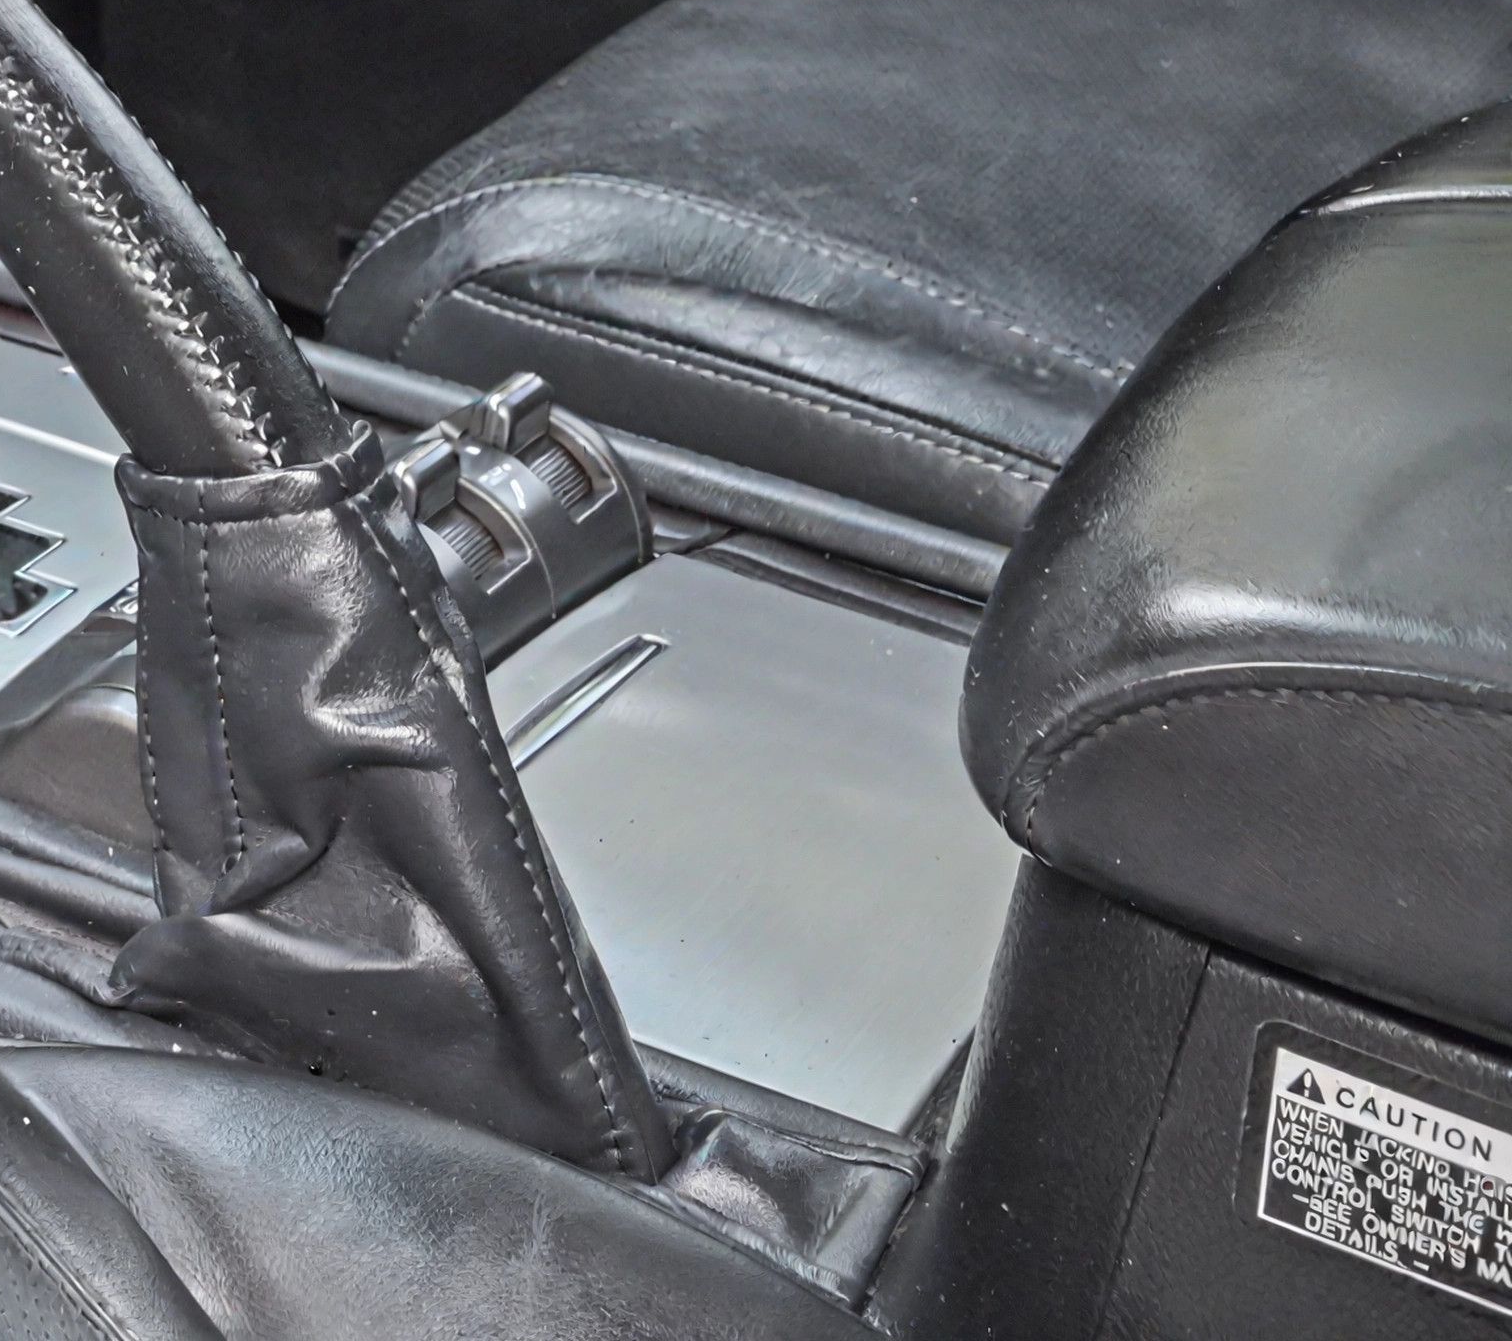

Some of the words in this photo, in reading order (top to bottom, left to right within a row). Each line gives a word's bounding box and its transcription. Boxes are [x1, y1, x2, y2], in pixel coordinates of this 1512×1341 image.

[1279, 1097, 1344, 1139] WHEN
[1336, 1087, 1493, 1161] CAUTION
[1272, 1158, 1376, 1213] CONTROL
[1380, 1159, 1414, 1188] OR
